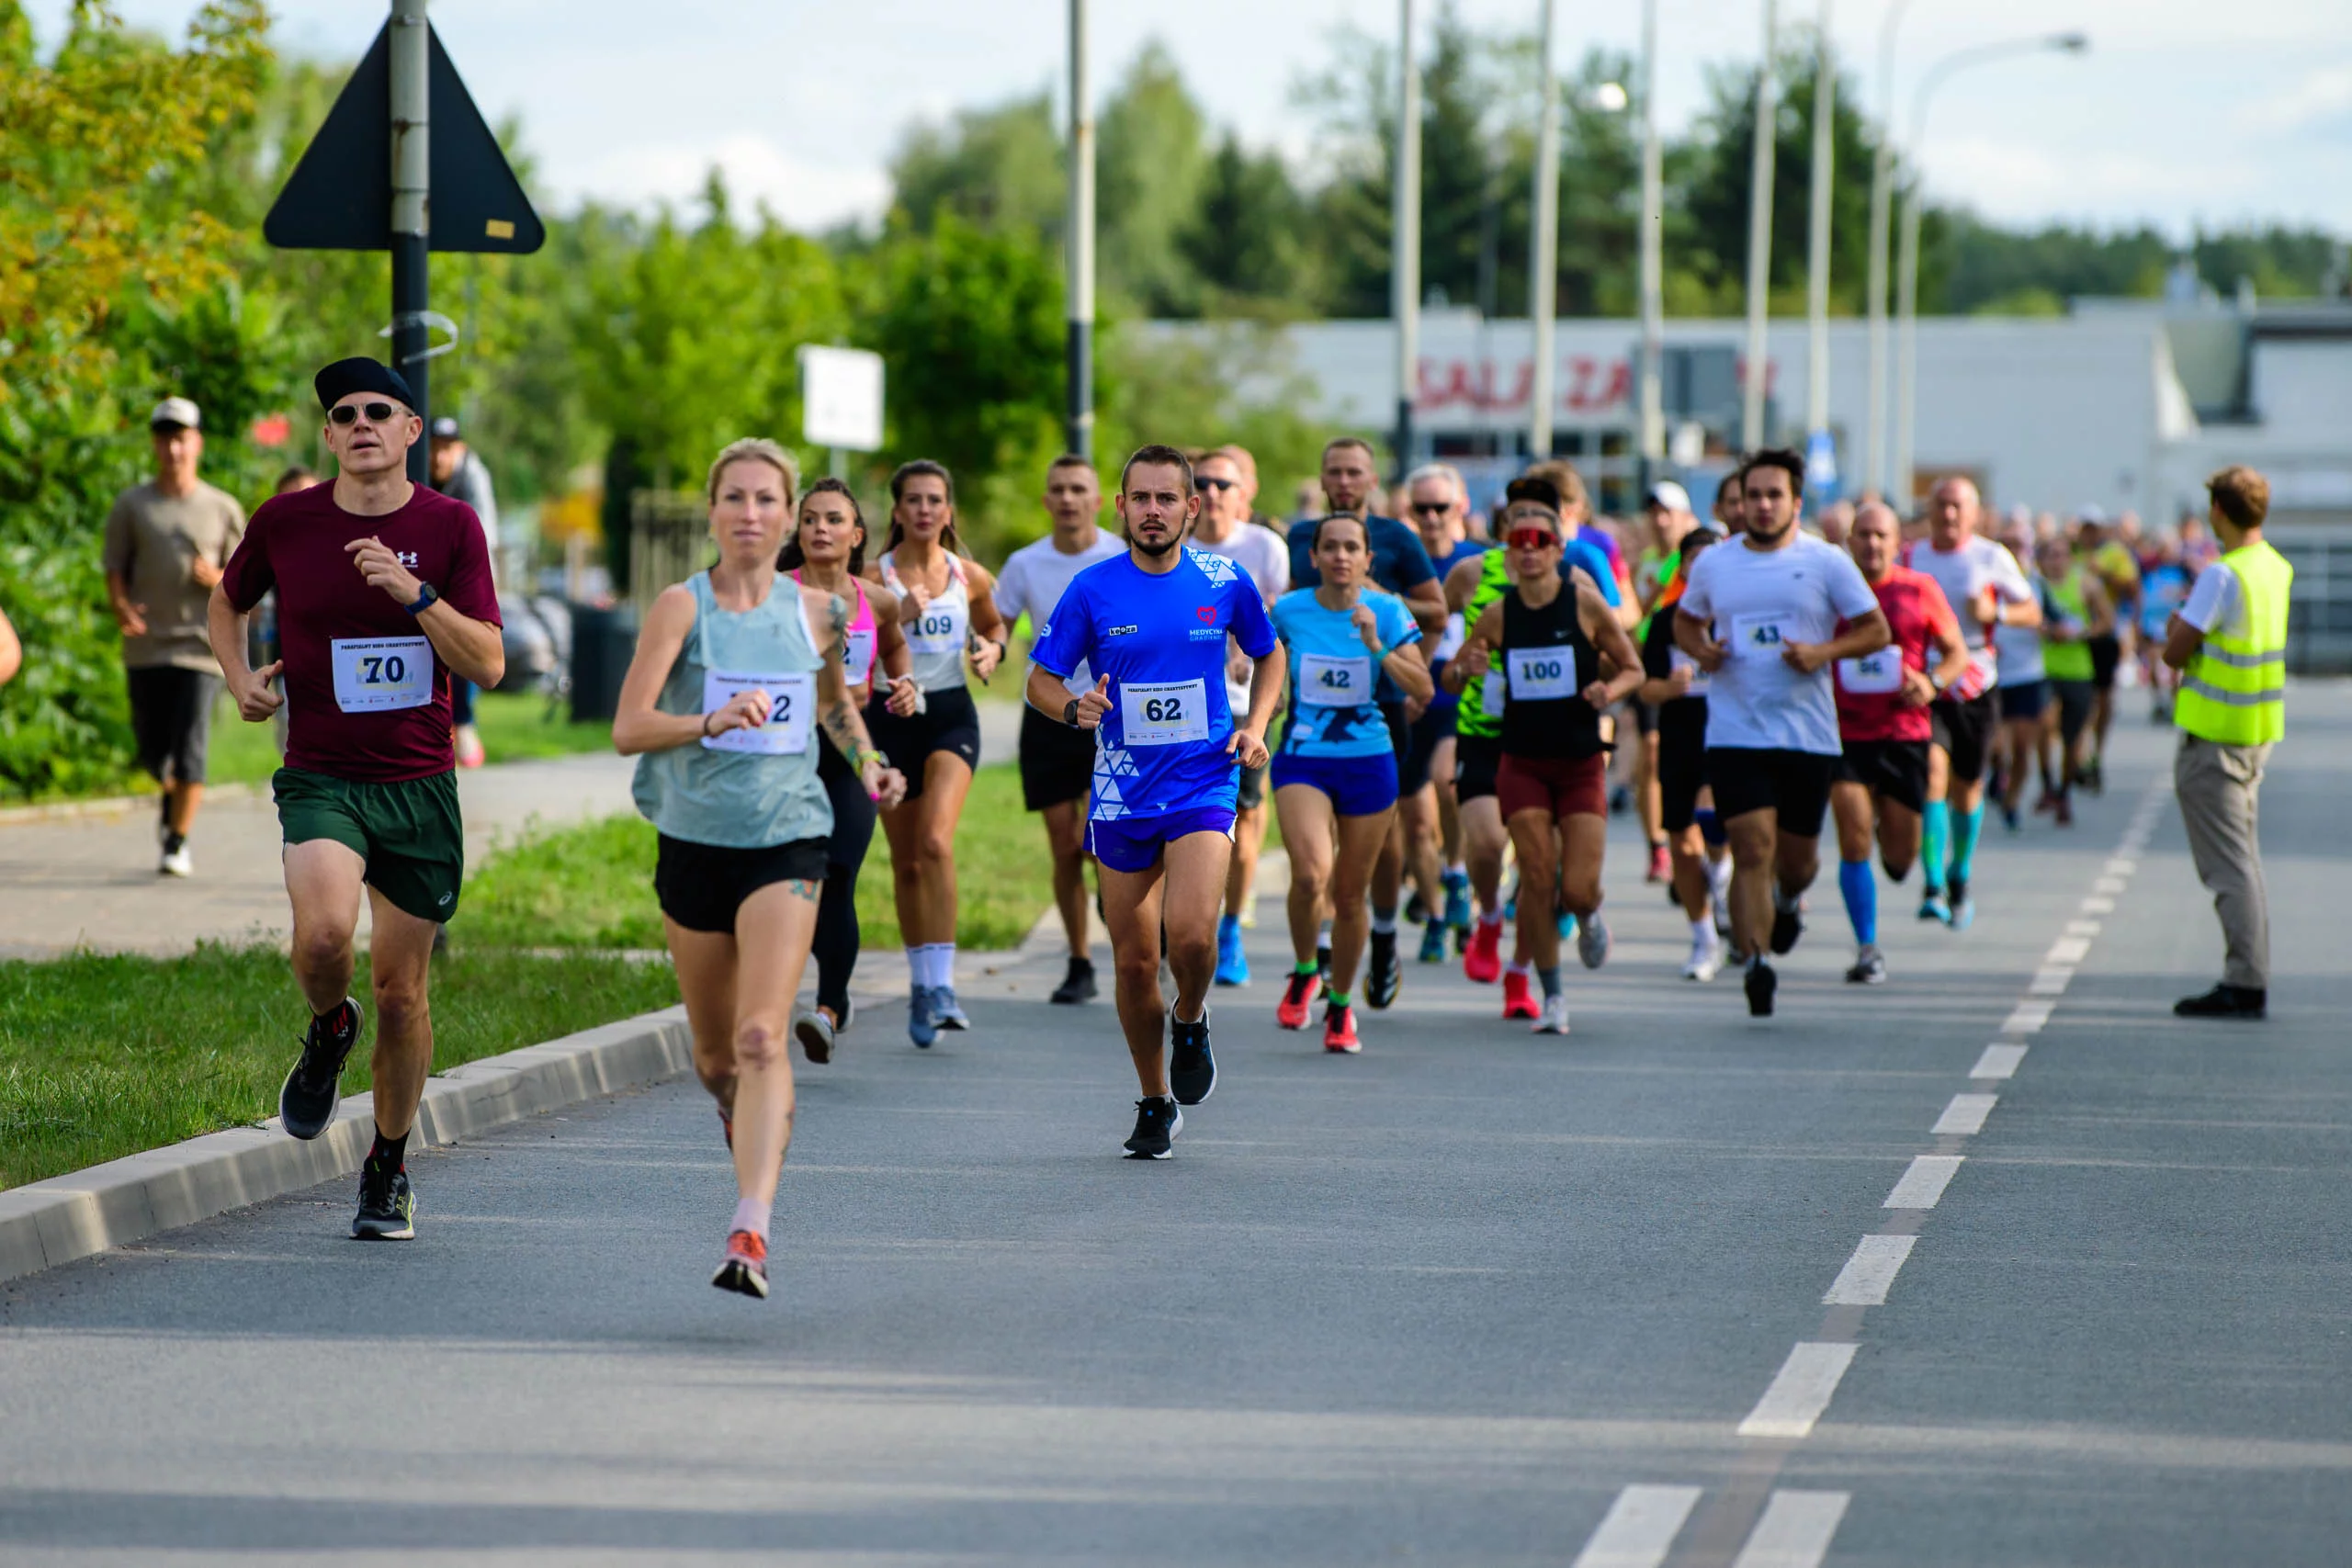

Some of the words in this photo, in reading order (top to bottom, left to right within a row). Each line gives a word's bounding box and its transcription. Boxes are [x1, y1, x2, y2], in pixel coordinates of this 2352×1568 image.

[912, 615, 952, 636] 109
[1754, 625, 1780, 643] 43
[363, 656, 404, 683] 70
[1321, 670, 1351, 688] 42
[1521, 661, 1561, 681] 100
[1146, 698, 1182, 722] 62
